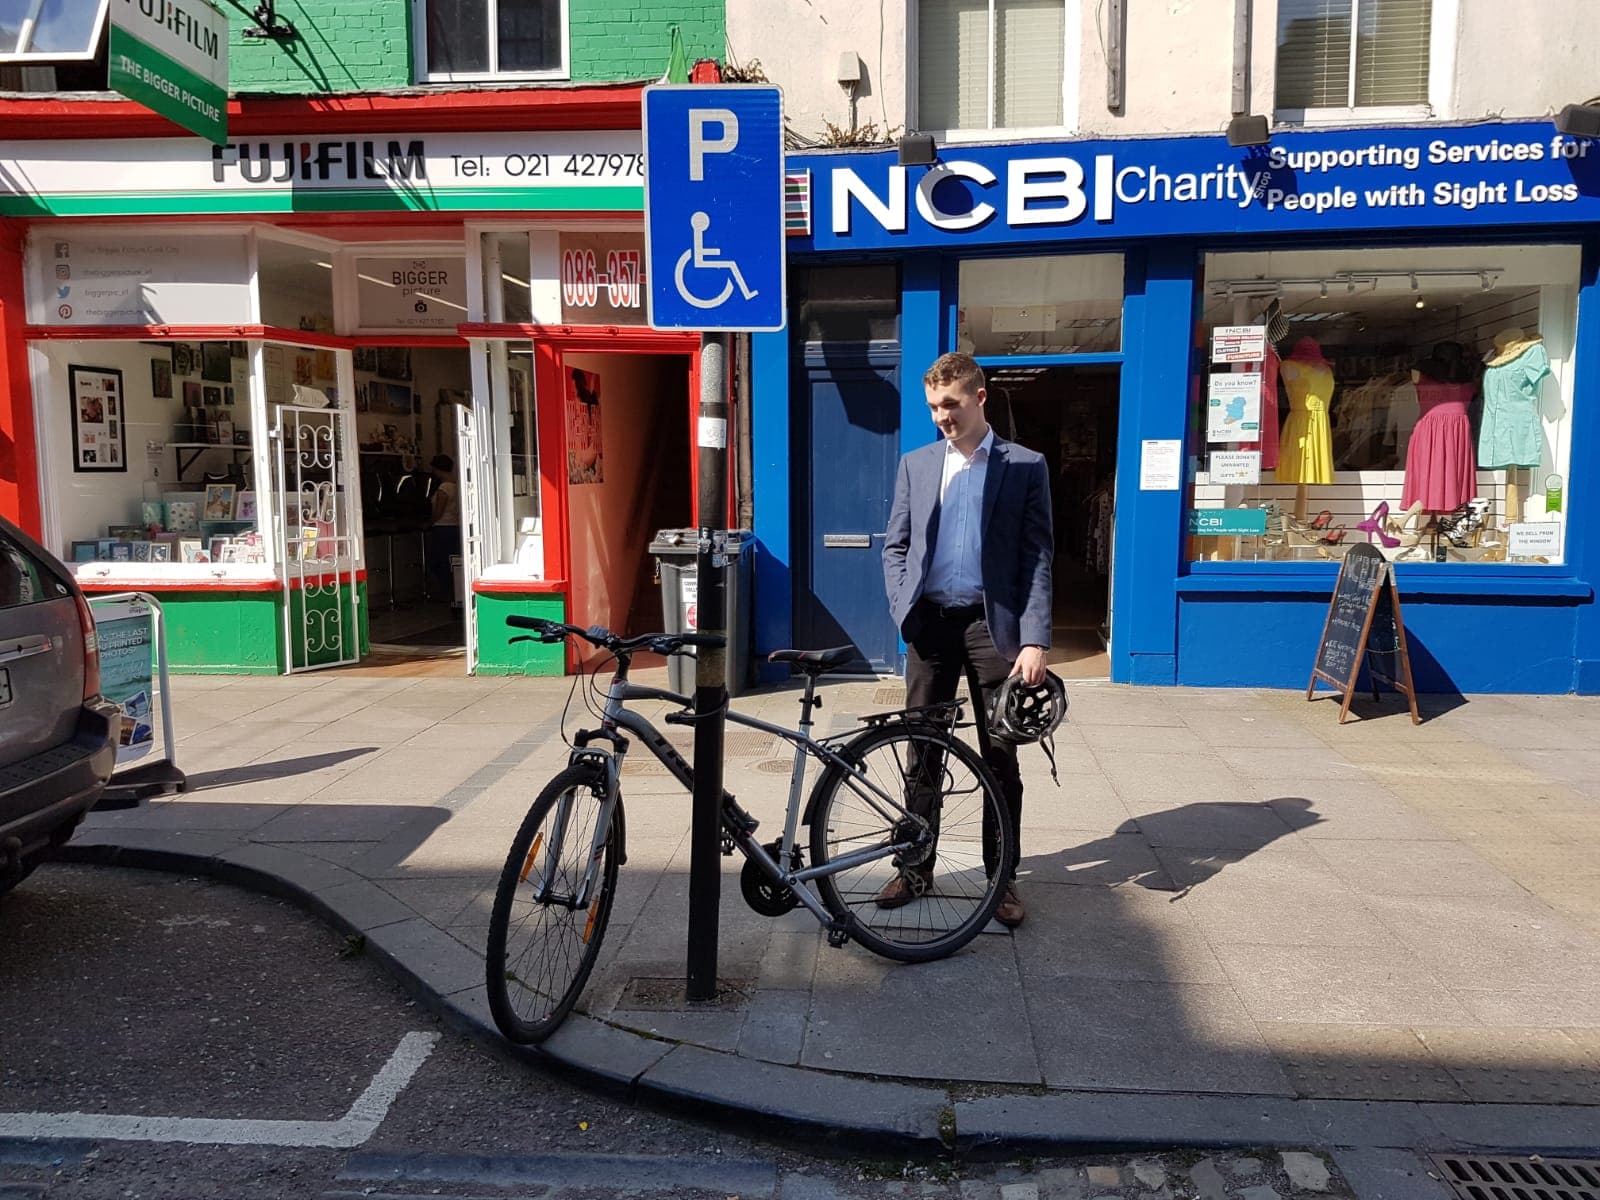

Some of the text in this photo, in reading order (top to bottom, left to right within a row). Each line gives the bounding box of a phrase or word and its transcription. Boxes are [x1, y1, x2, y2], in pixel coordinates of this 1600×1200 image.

[128, 0, 218, 60] UJIFILM
[120, 54, 220, 122] THE BIGGER PICTURE
[688, 108, 739, 181] P
[1268, 135, 1590, 173] Supporting Services for
[211, 140, 426, 183] FUJIFILM
[450, 154, 491, 177] Tel:
[504, 153, 549, 177] 021
[831, 154, 1261, 233] NCBI Charity
[1254, 171, 1273, 199] Shop
[1267, 179, 1578, 213] People with Sight Loss
[392, 271, 448, 285] BIGGER
[403, 287, 441, 297] picture
[1189, 518, 1223, 526] NCBI
[109, 636, 143, 649] PRINTED
[110, 631, 126, 640] THE
[128, 627, 148, 637] LAST
[100, 647, 136, 658] PHOTOS?
